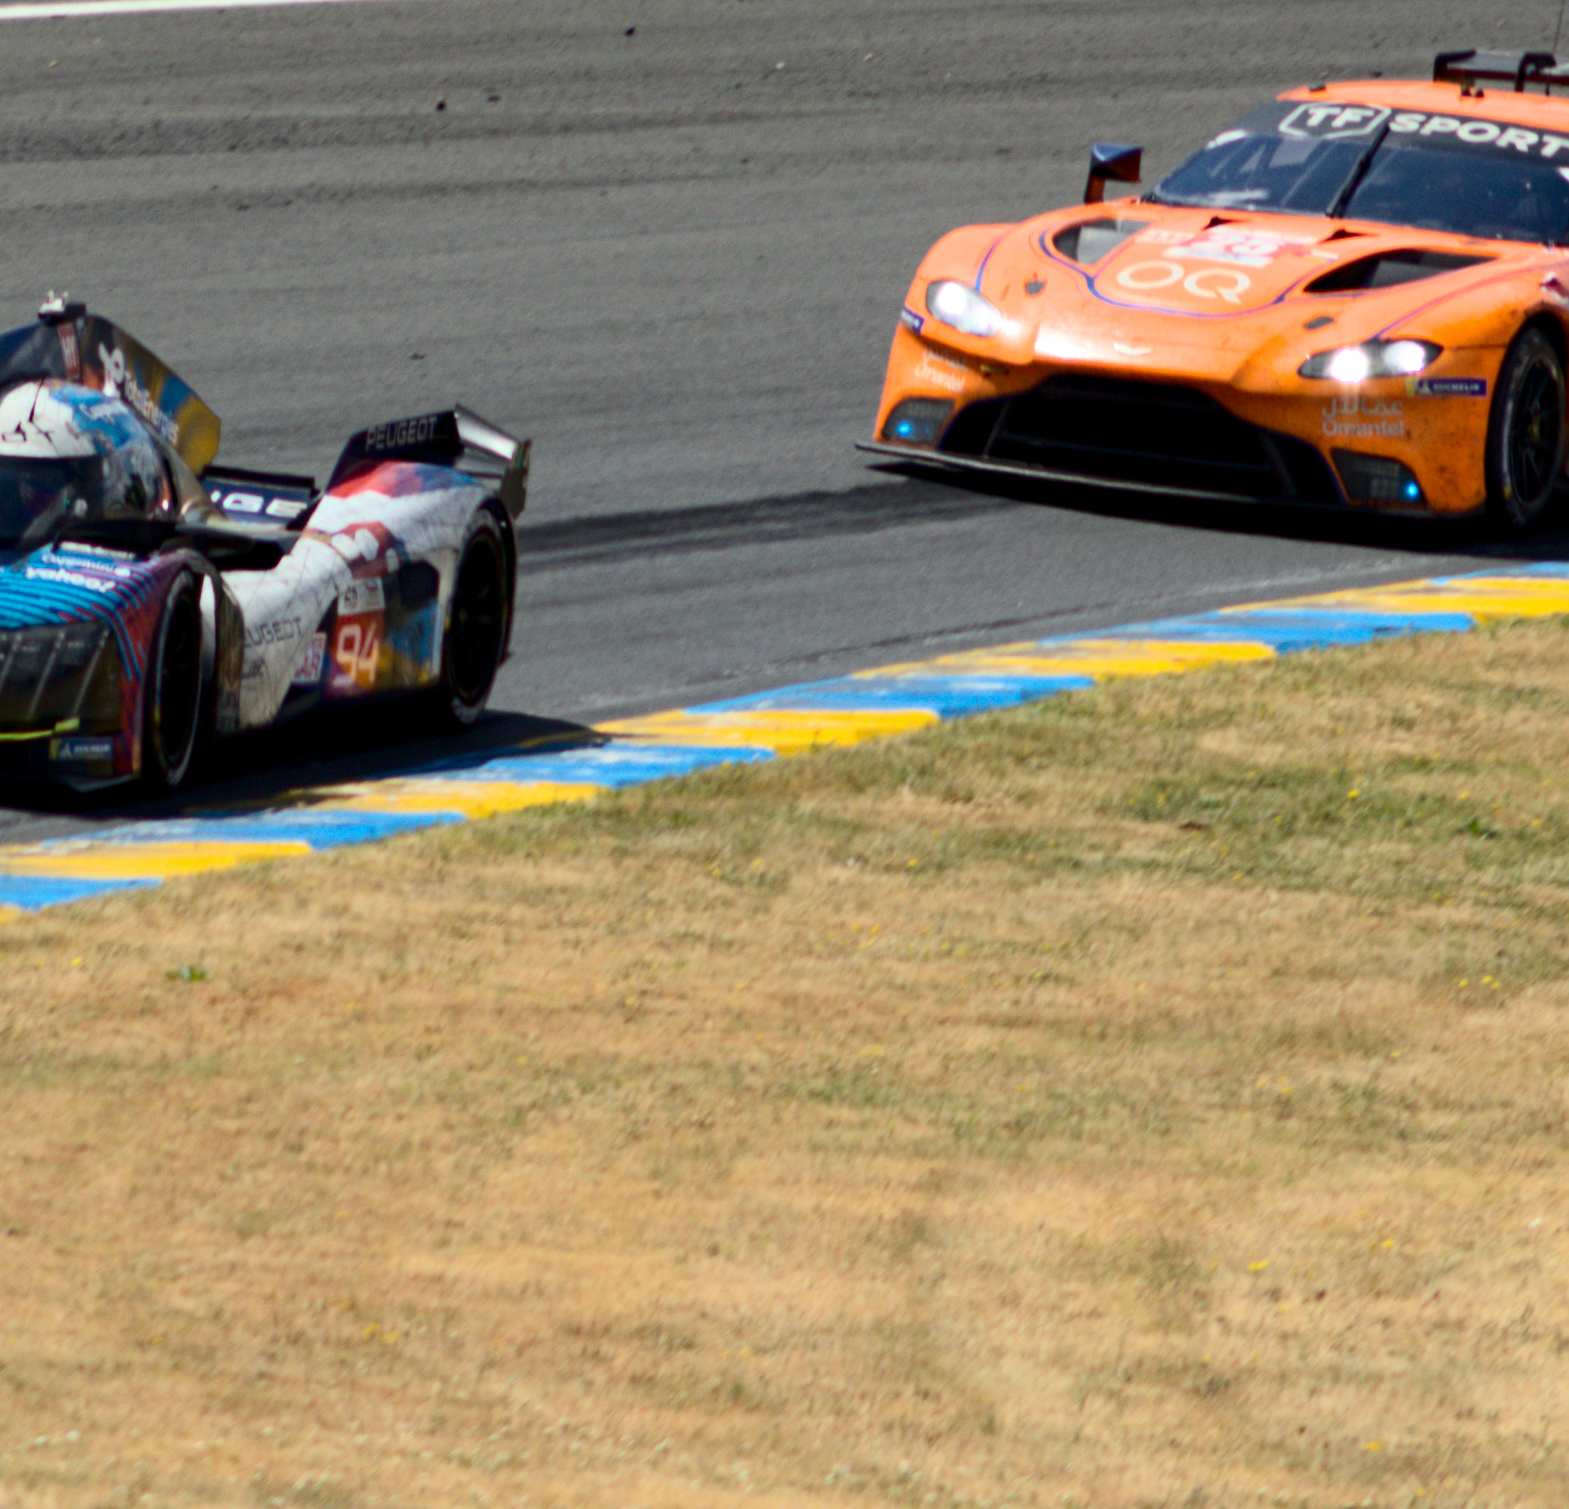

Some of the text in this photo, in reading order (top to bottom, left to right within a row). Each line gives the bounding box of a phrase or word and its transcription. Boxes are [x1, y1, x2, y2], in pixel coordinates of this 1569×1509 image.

[1306, 106, 1375, 128] TF
[1115, 260, 1251, 304] OQ
[365, 416, 439, 453] PEUGEOT
[1322, 416, 1404, 437] Omantel
[26, 566, 117, 593] yahoo!
[335, 622, 381, 684] 94
